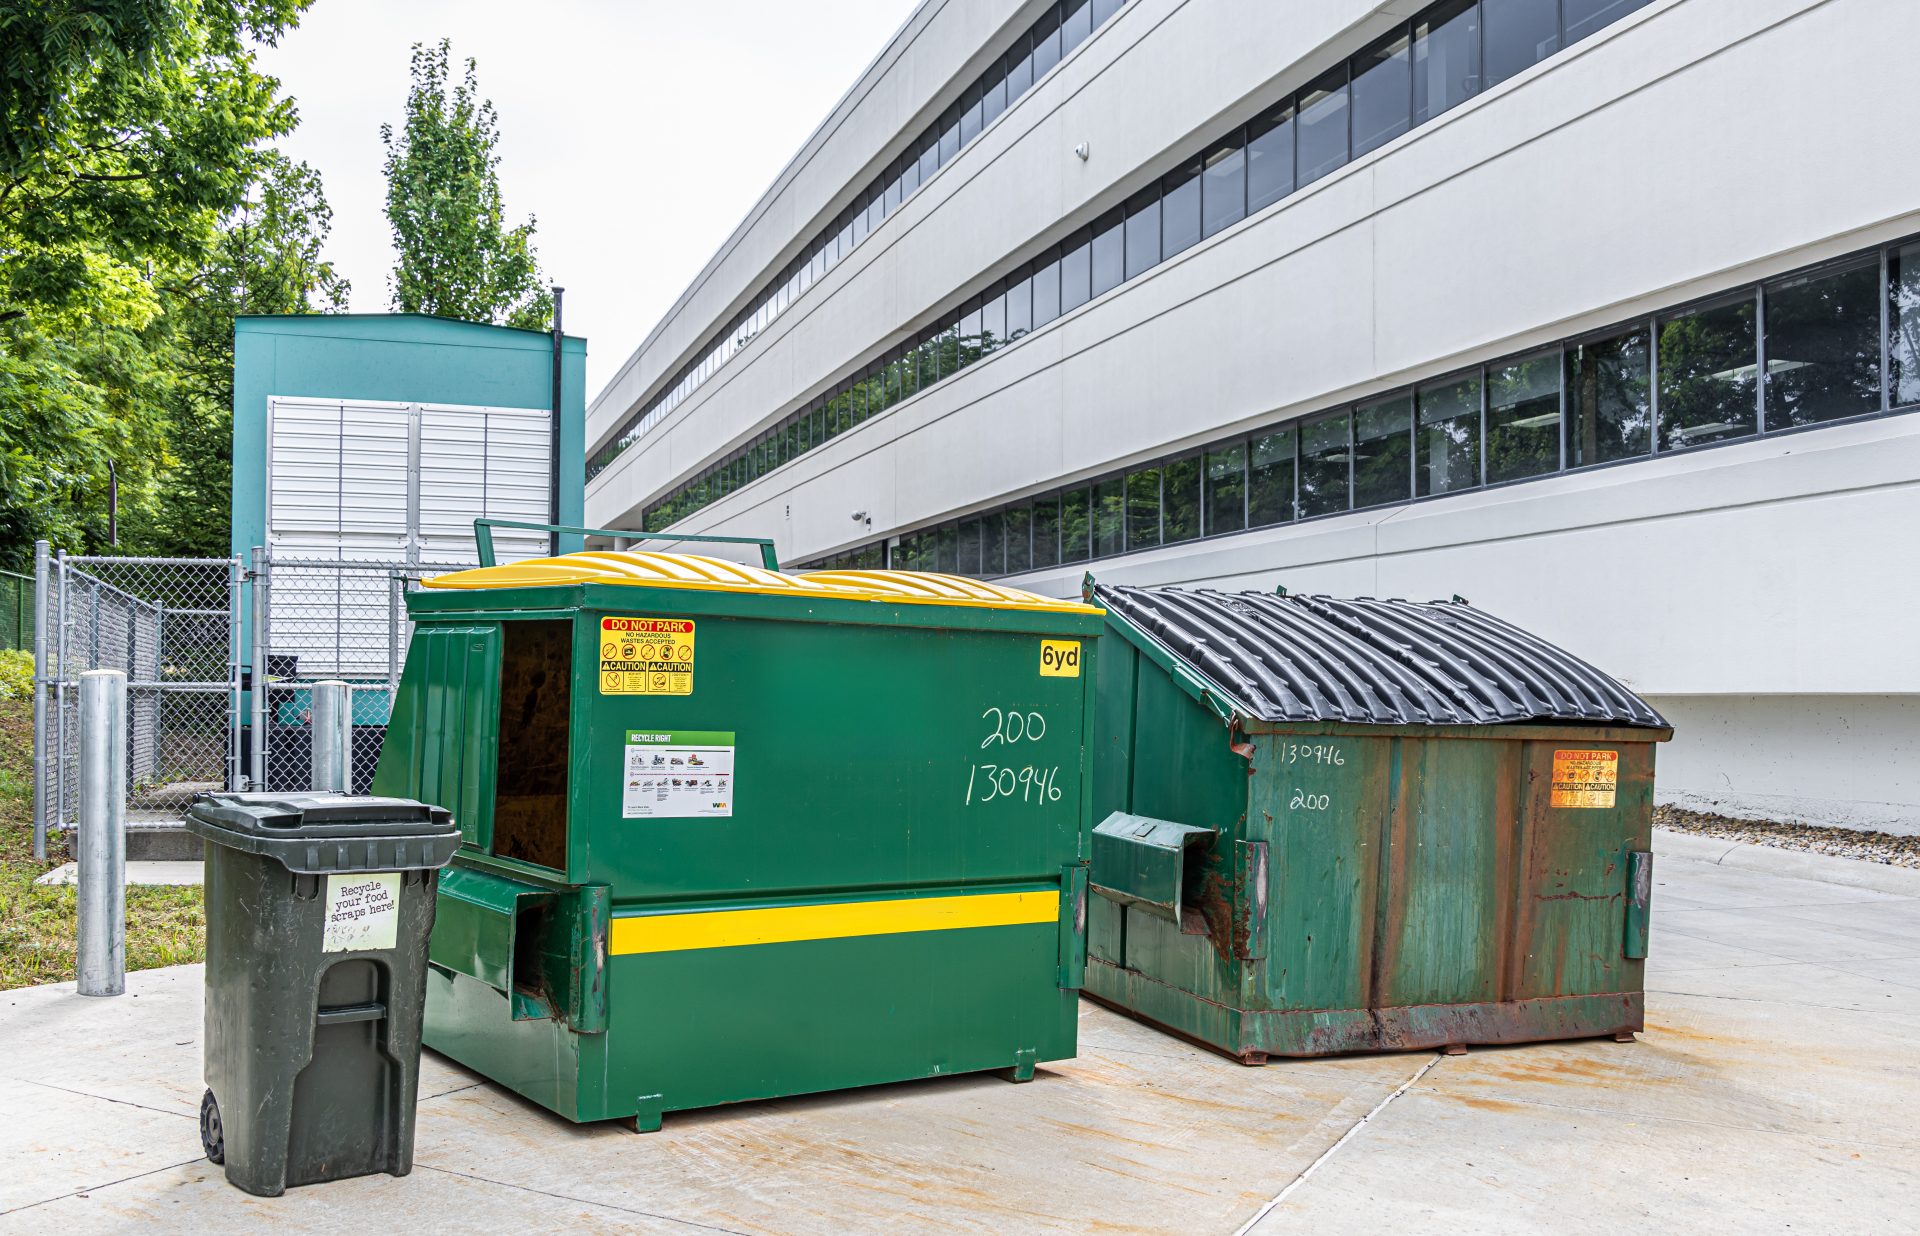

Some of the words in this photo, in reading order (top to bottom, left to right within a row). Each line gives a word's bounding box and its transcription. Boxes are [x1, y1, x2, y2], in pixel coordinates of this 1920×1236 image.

[611, 619, 628, 631] DO
[631, 620, 654, 631] NOT
[656, 621, 686, 632] PARK
[610, 661, 646, 671] CAUTION
[656, 662, 692, 672] CAUTION
[1042, 645, 1079, 671] 6yd
[981, 707, 1046, 749] 200
[631, 733, 655, 742] RECYCLE
[655, 734, 672, 743] RIGHT
[1281, 742, 1345, 766] 130946
[1560, 752, 1573, 760] DO
[1574, 752, 1590, 760] NOT
[1591, 752, 1612, 760] PARK
[966, 764, 1062, 806] 130946
[1590, 783, 1615, 791] CAUTION
[1289, 788, 1330, 811] 200
[341, 882, 381, 897] Recycle
[336, 897, 361, 912] your
[365, 890, 388, 904] food
[331, 909, 366, 922] scraps
[369, 900, 394, 914] here!
